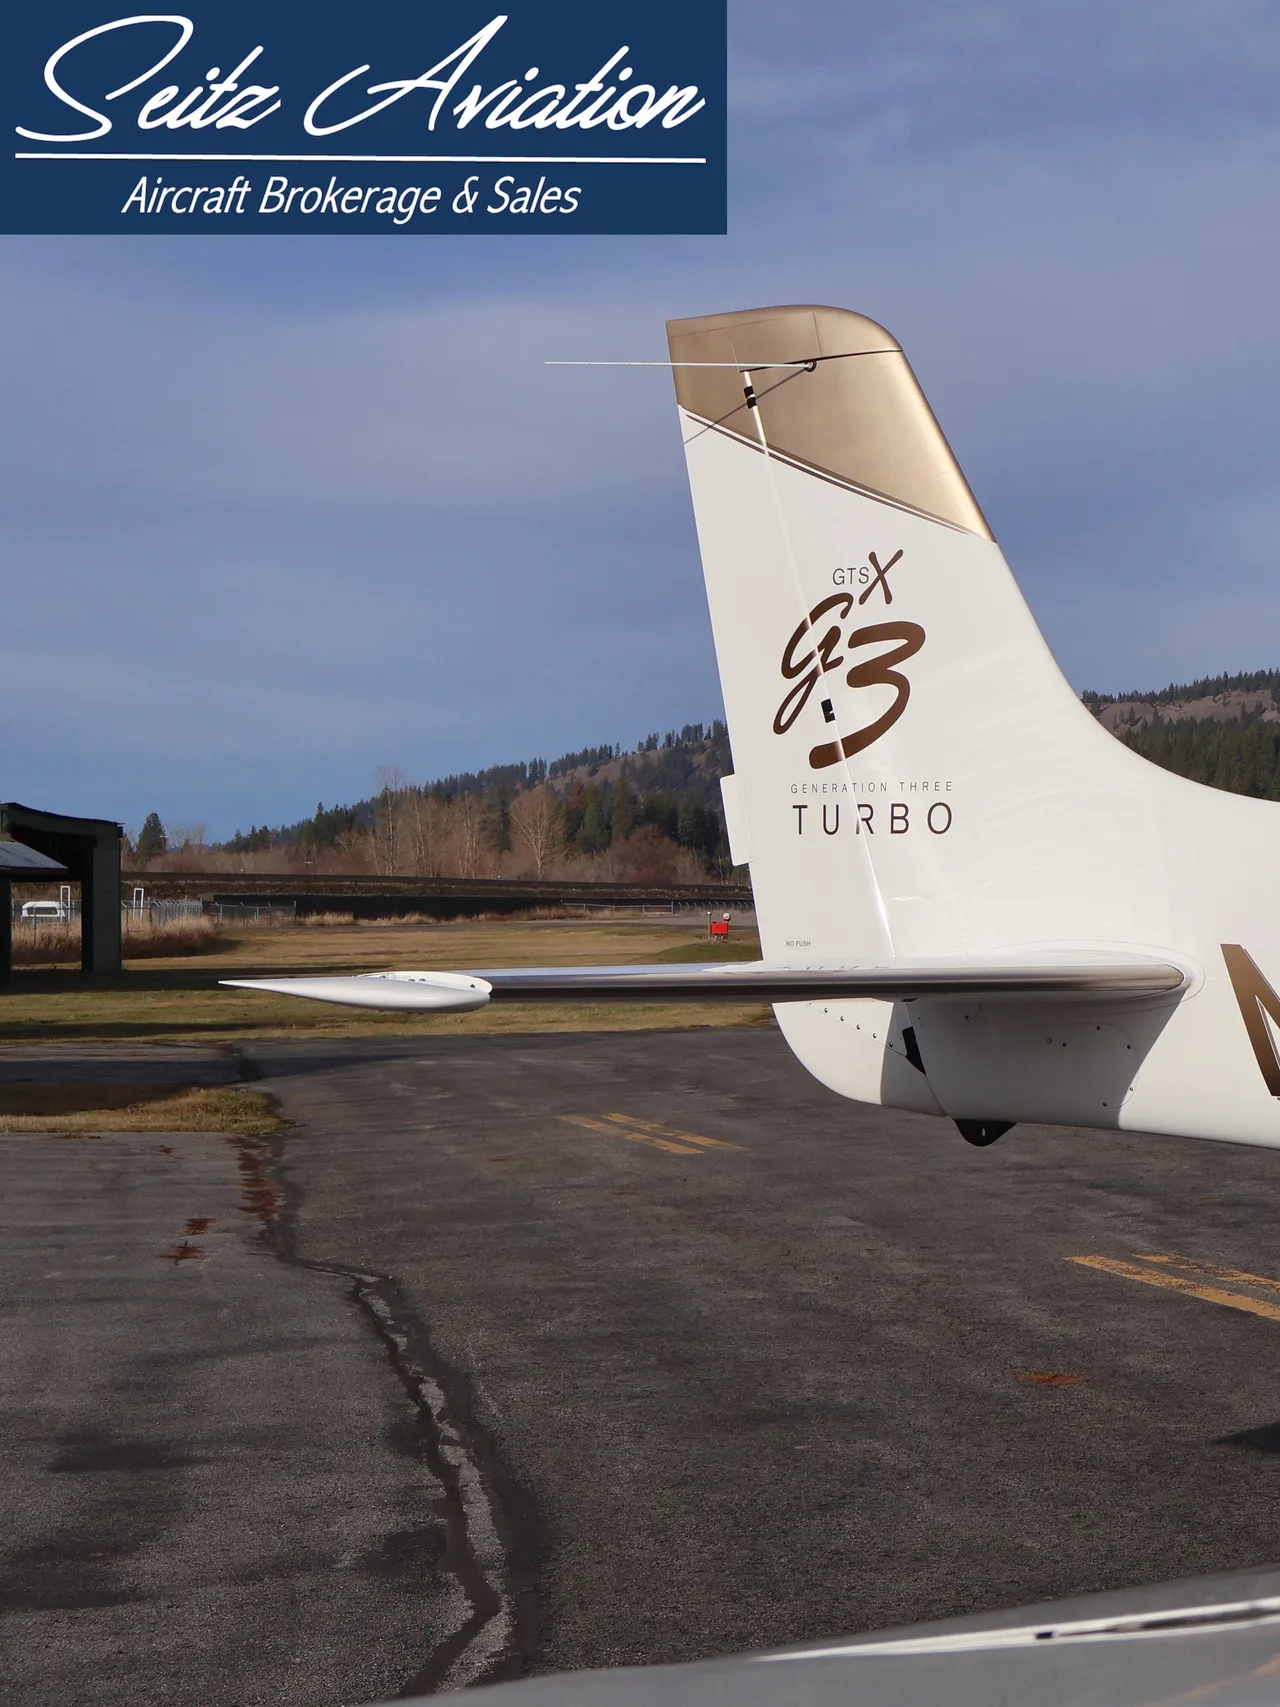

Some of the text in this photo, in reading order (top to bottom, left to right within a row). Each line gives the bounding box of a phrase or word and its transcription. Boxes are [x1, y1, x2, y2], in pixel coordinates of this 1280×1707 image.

[790, 781, 952, 794] GENERATION THREE
[792, 801, 953, 835] TURBO
